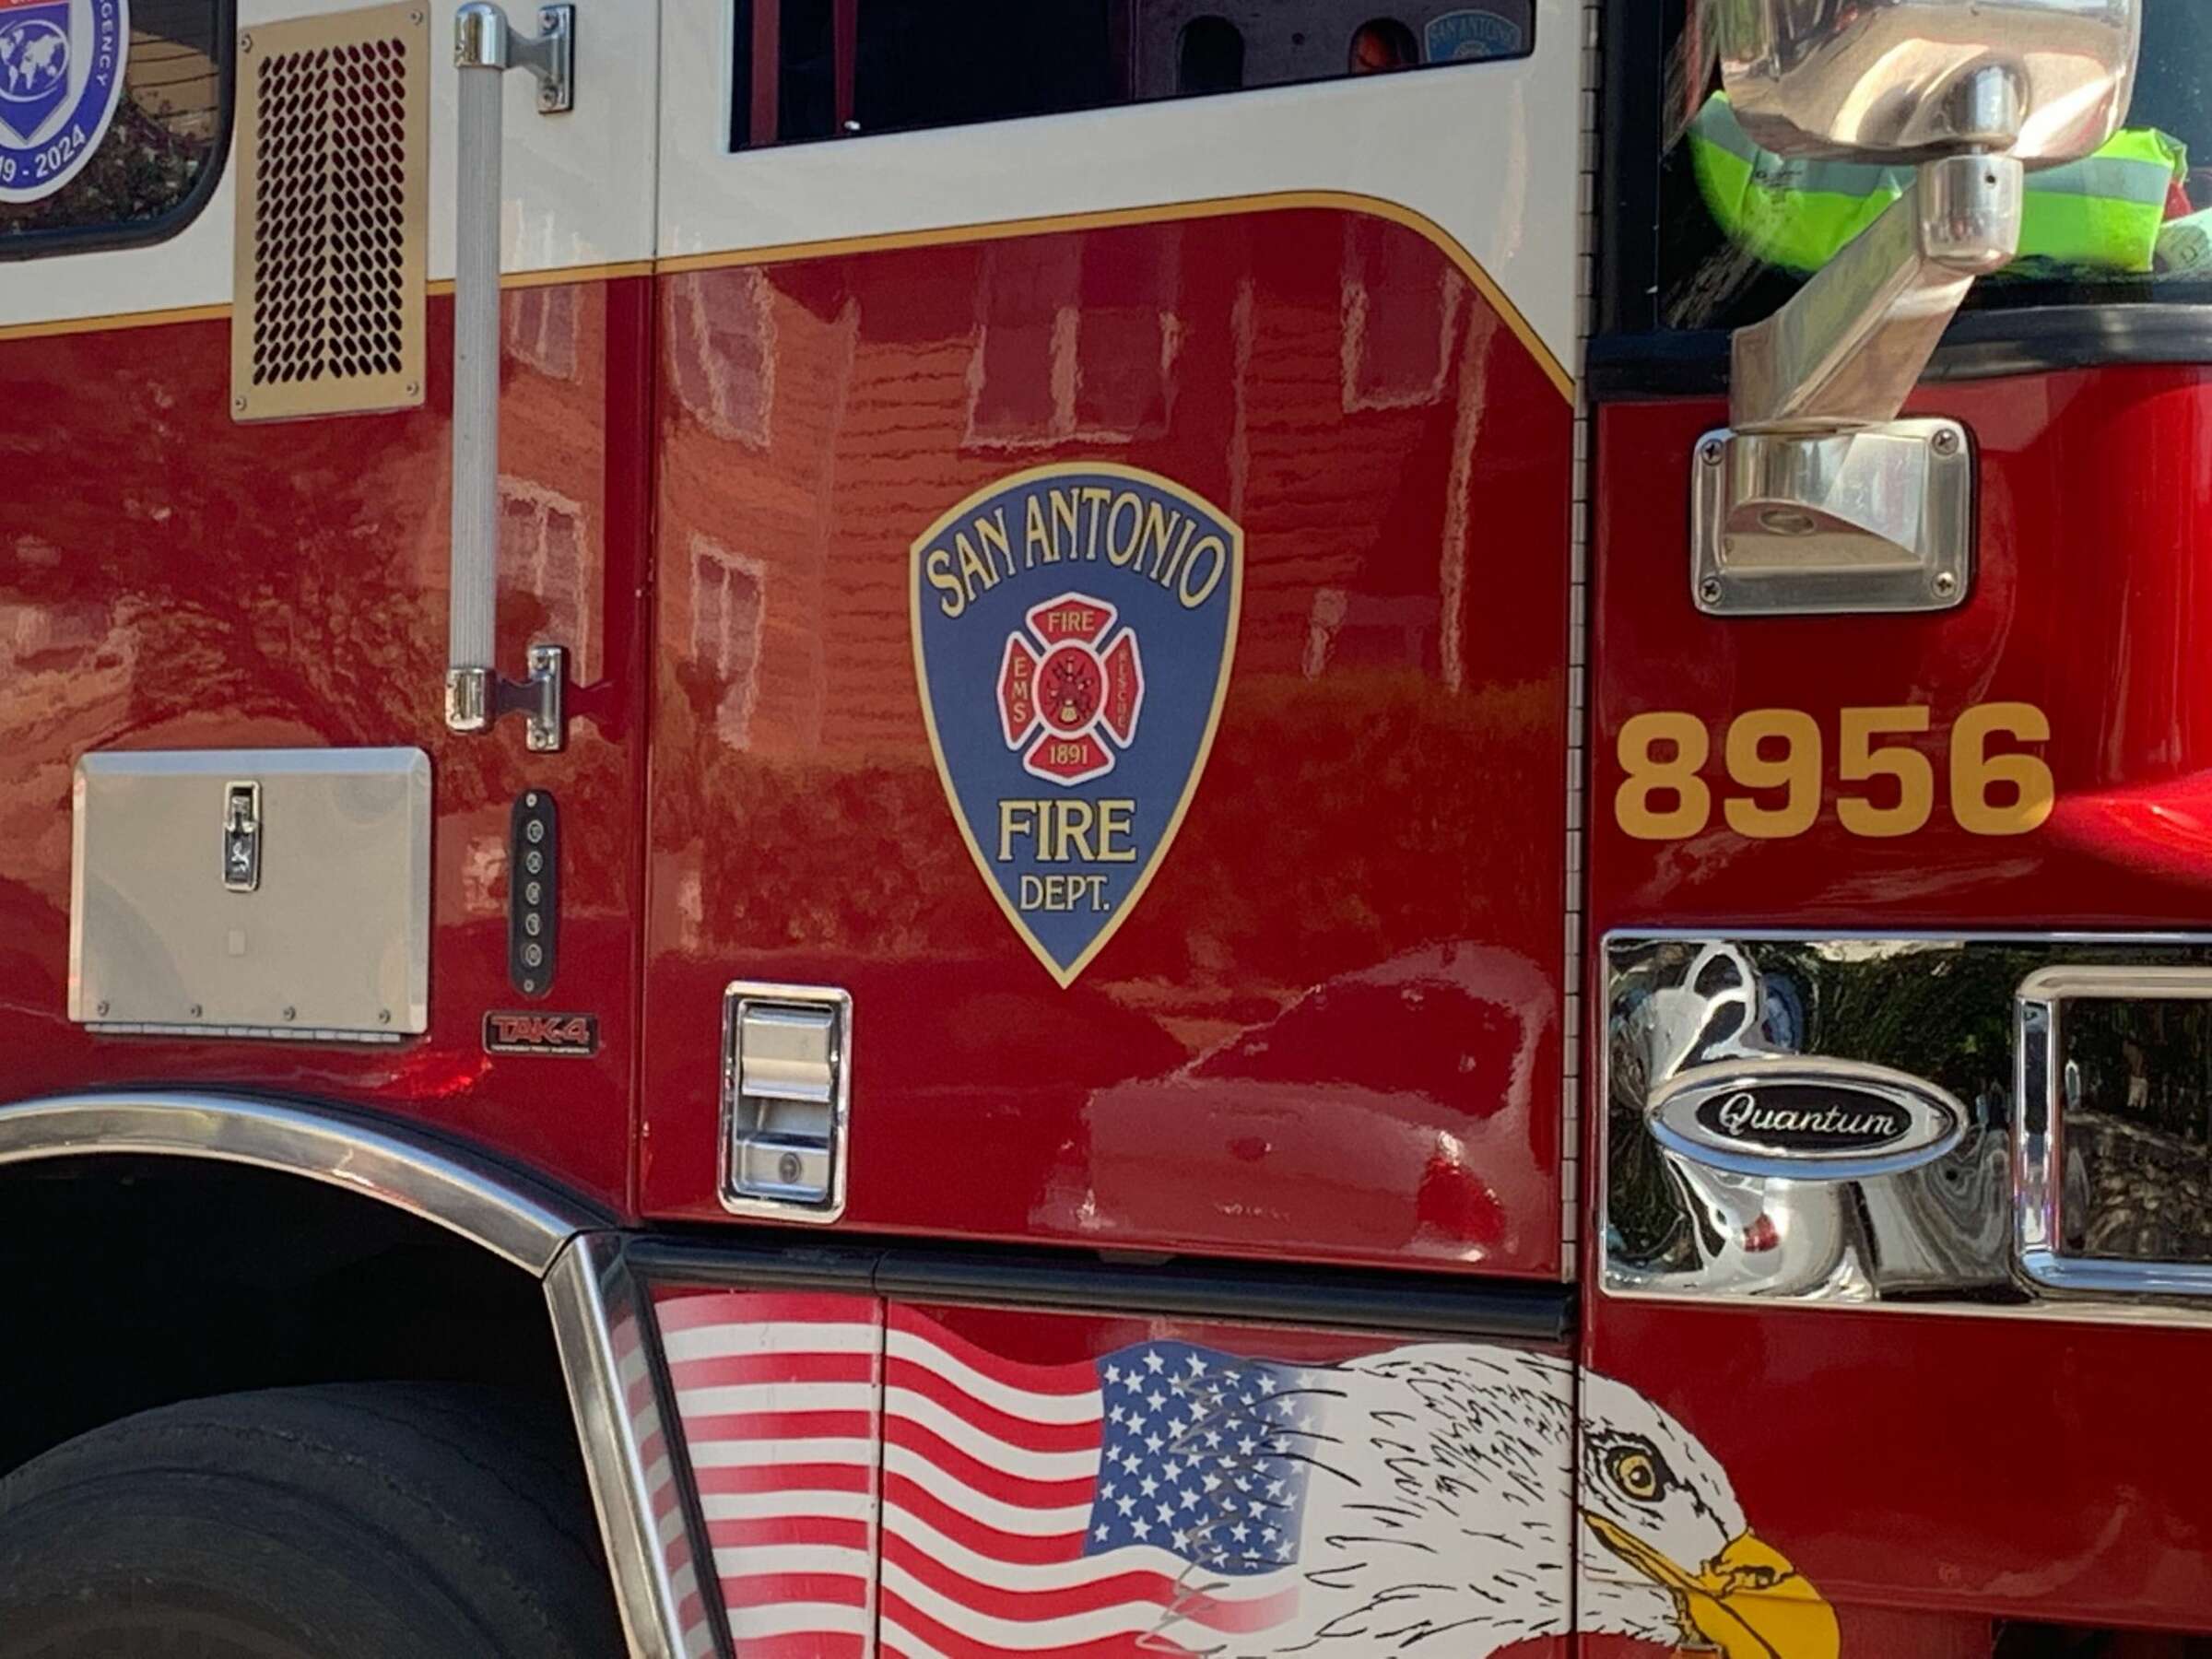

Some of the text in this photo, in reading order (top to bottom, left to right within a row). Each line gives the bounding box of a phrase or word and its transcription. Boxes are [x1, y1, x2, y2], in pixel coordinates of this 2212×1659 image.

[96, 0, 113, 87] GENCY
[35, 124, 86, 178] 2024
[925, 487, 1227, 618] SAN ANTONIO
[1047, 610, 1095, 633] FIRE
[1012, 655, 1028, 724] EMS
[1049, 743, 1088, 765] 1891
[1615, 701, 2054, 840] 8956
[997, 799, 1137, 863] FIRE
[1019, 875, 1110, 912] DEPT.
[490, 1015, 590, 1044] TAK-4
[1719, 1092, 1897, 1135] Quantum
